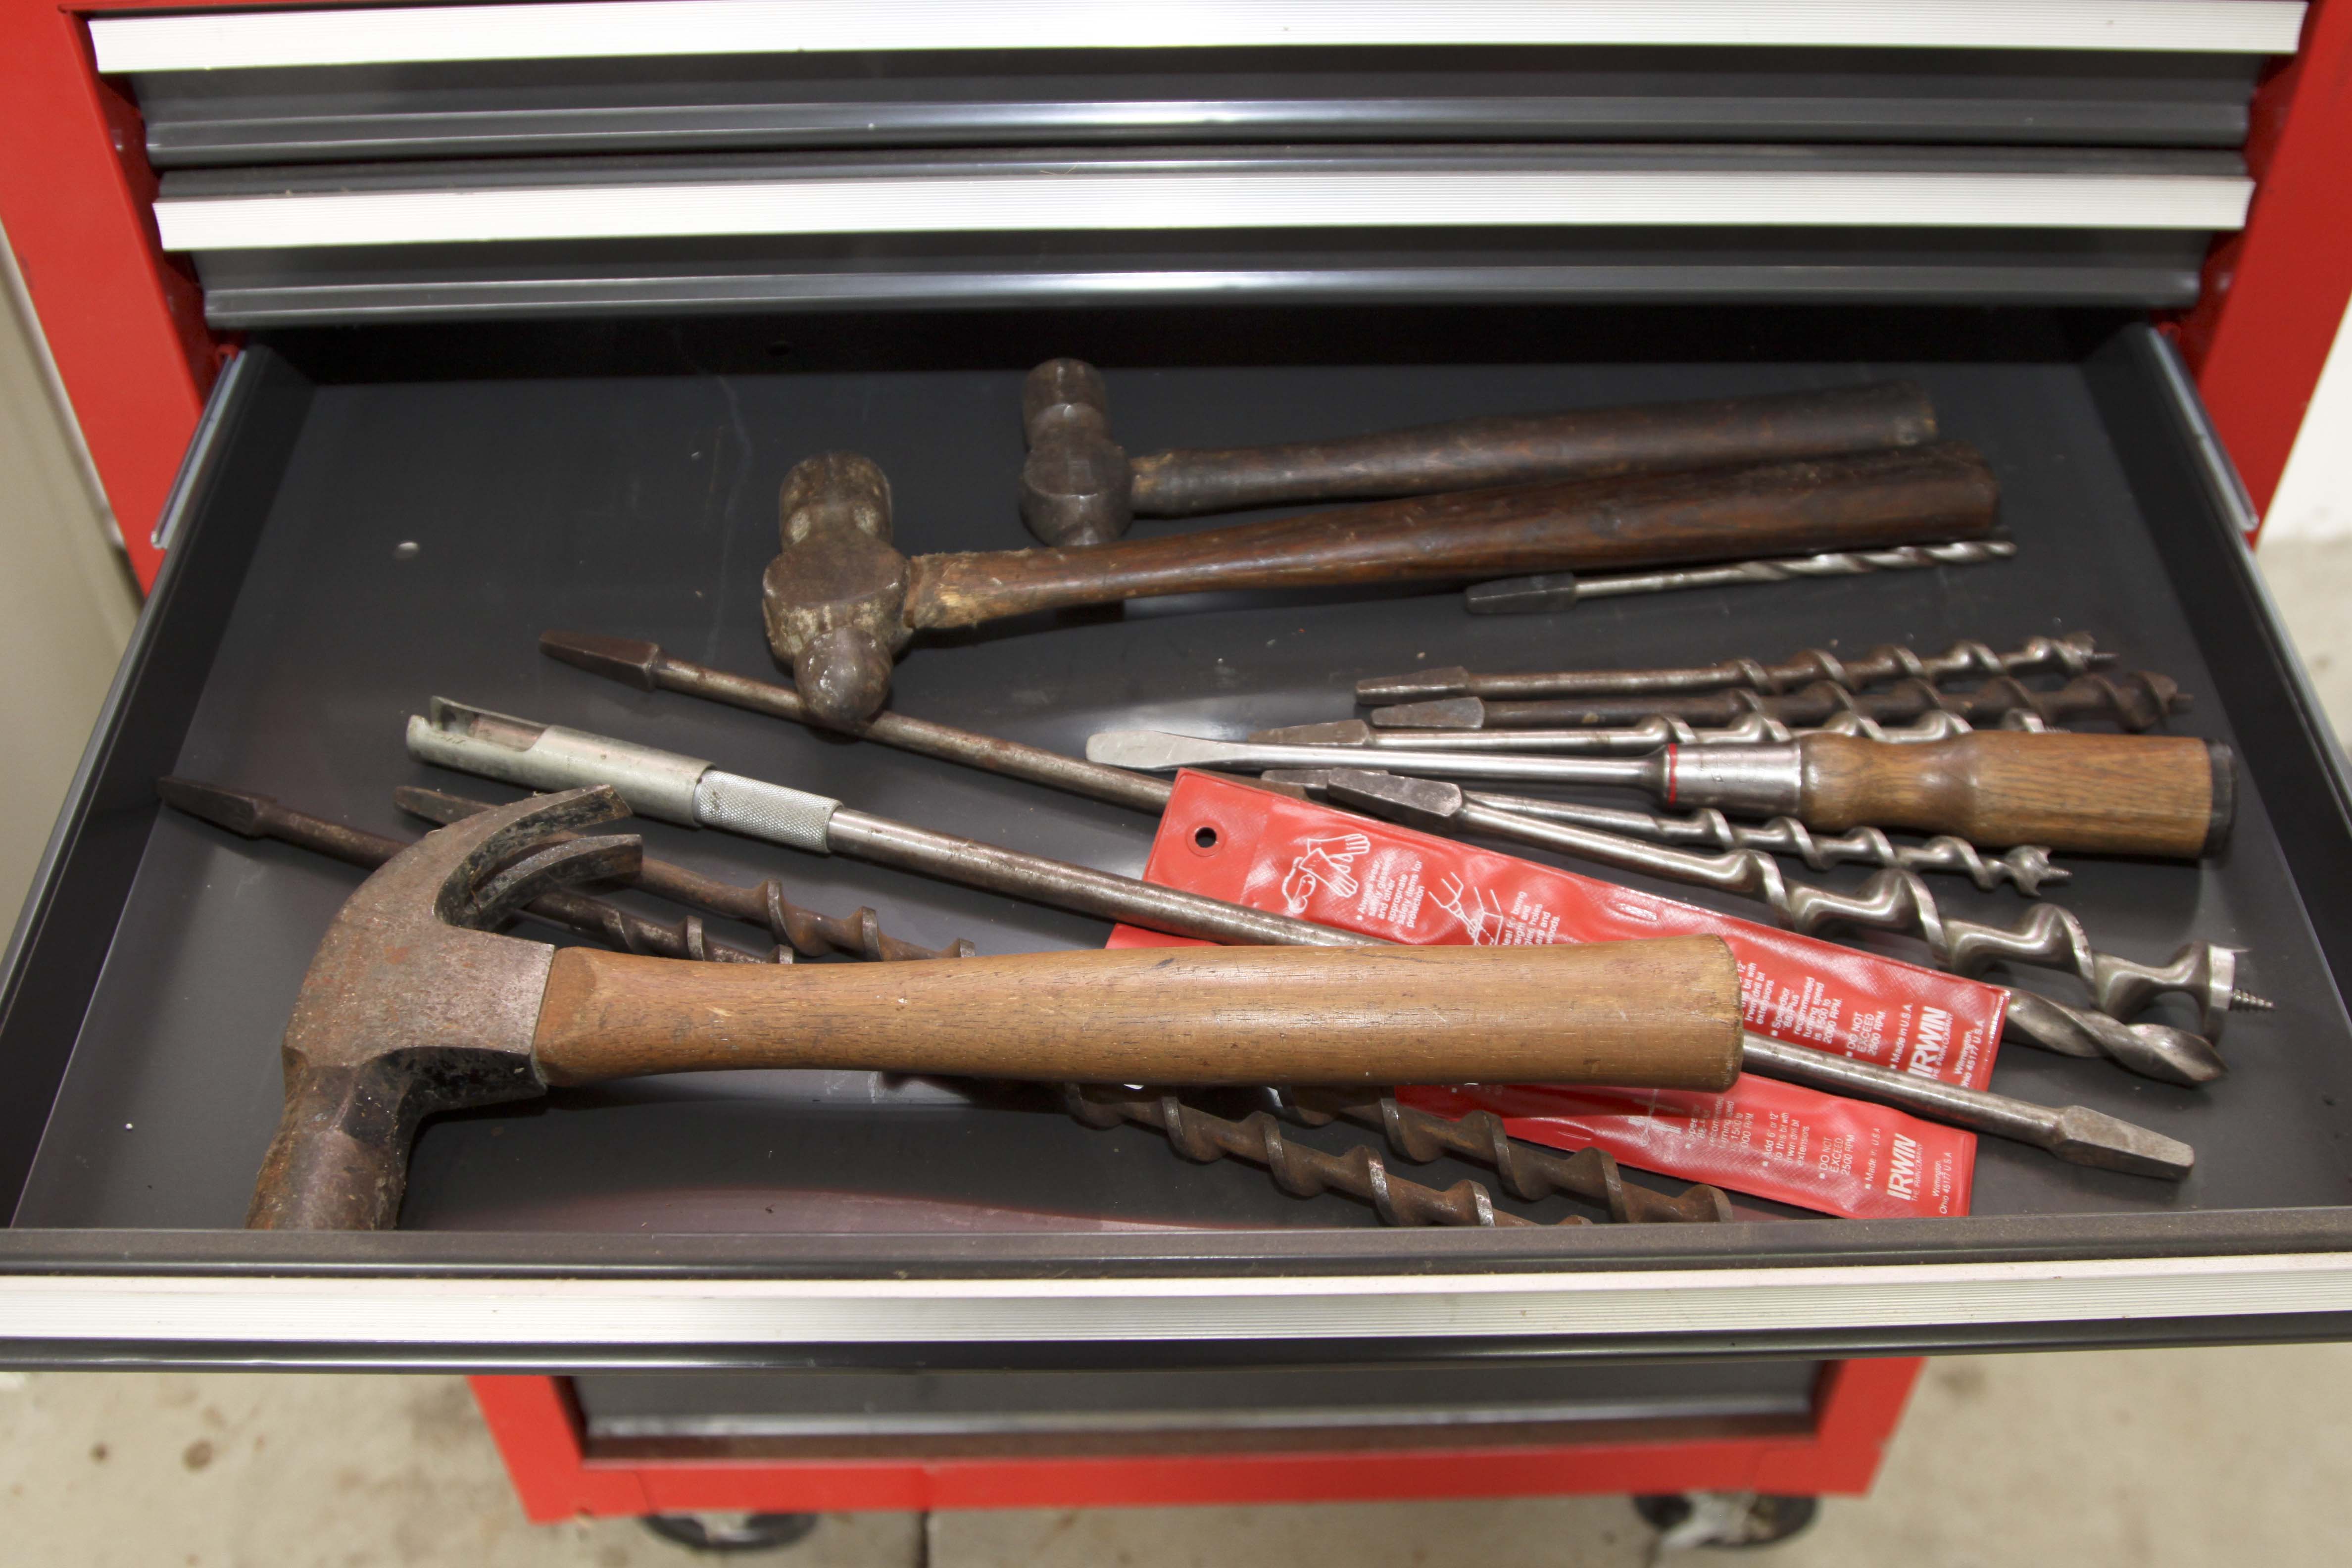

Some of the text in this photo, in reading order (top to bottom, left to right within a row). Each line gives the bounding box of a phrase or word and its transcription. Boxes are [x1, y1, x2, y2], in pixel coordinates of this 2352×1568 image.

[1378, 879, 1395, 919] and other
[1388, 874, 1407, 922] appropriate
[1397, 860, 1422, 925] safety items for
[1511, 890, 1528, 915] boring
[1407, 885, 1424, 928] protection
[1521, 905, 1531, 920] and
[1529, 903, 1542, 925] holes
[1507, 917, 1516, 928] for
[1540, 911, 1551, 928] and
[1746, 962, 1757, 977] with
[1743, 979, 1752, 988] bit
[1745, 972, 1765, 1021] Irwin drill bit
[1771, 987, 1790, 1029] Speedbor
[1794, 977, 1815, 1035] recommended
[1803, 982, 1824, 1038] turning speed
[1816, 1008, 1828, 1029] 1500
[1813, 1032, 1822, 1040] is
[1822, 1020, 1836, 1043] 2000
[1847, 1012, 1863, 1049] DO NOT
[1857, 1013, 1874, 1053] EXCEED
[1891, 1036, 1906, 1062] Made
[1899, 1002, 1913, 1027] U.S.A.
[1909, 1006, 1948, 1077] IRWIN
[1867, 1032, 1880, 1055] 2500
[1965, 1044, 1979, 1070] 45177
[1780, 1112, 1789, 1123] with
[1732, 1120, 1741, 1139] 1500
[1789, 1127, 1798, 1140] drill
[1764, 1140, 1773, 1158] Add
[1776, 1134, 1786, 1149] this
[1774, 1152, 1783, 1161] to
[1819, 1137, 1832, 1170] DO NOT
[1829, 1137, 1844, 1173] EXCEED
[1841, 1153, 1852, 1176] 2500
[1864, 1158, 1876, 1181] Made
[1886, 1133, 1916, 1200] IRWIN
[1911, 1143, 1926, 1201] THE IRWIN COMPANY
[1941, 1172, 1952, 1193] 45177
[1939, 1194, 1950, 1214] Ohio
